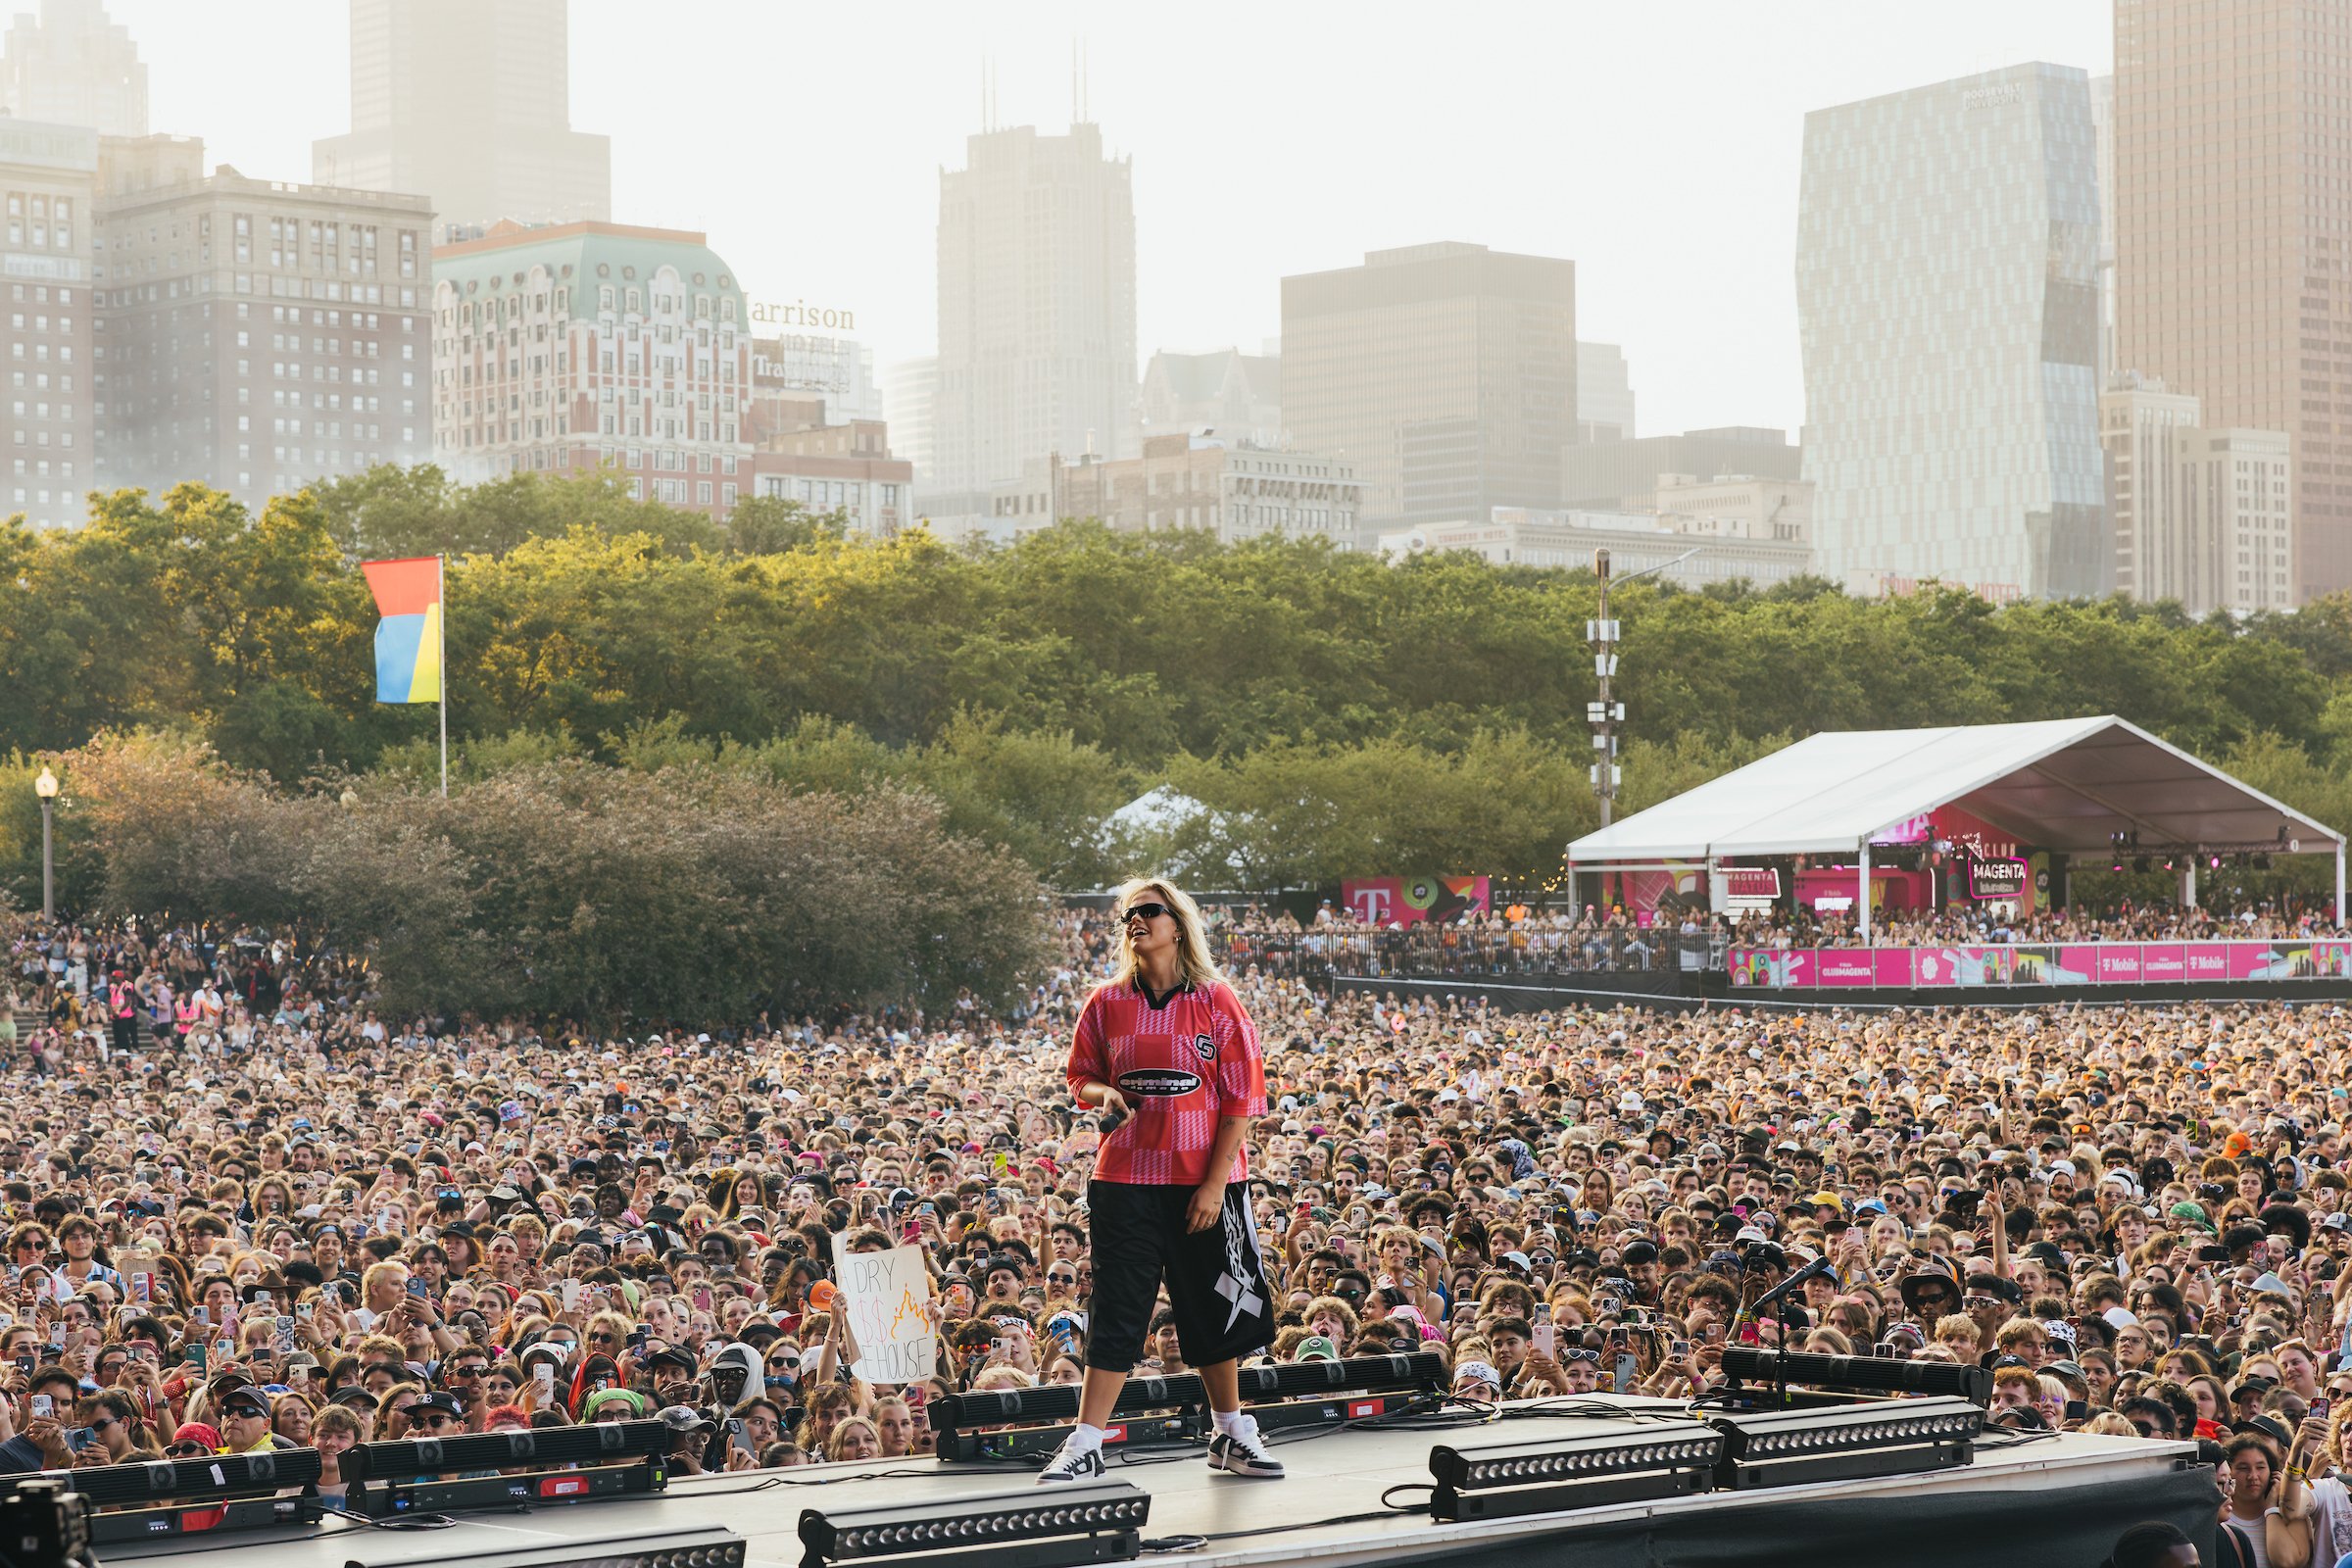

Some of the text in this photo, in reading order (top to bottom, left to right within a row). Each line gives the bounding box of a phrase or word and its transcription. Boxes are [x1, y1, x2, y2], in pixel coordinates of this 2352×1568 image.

[754, 354, 784, 377] Tra
[1984, 843, 2016, 858] CLUB
[1974, 863, 2027, 879] MAGENTA
[2112, 958, 2138, 971] Mobile
[2198, 956, 2225, 969] Mobile
[855, 1257, 896, 1294] DRY
